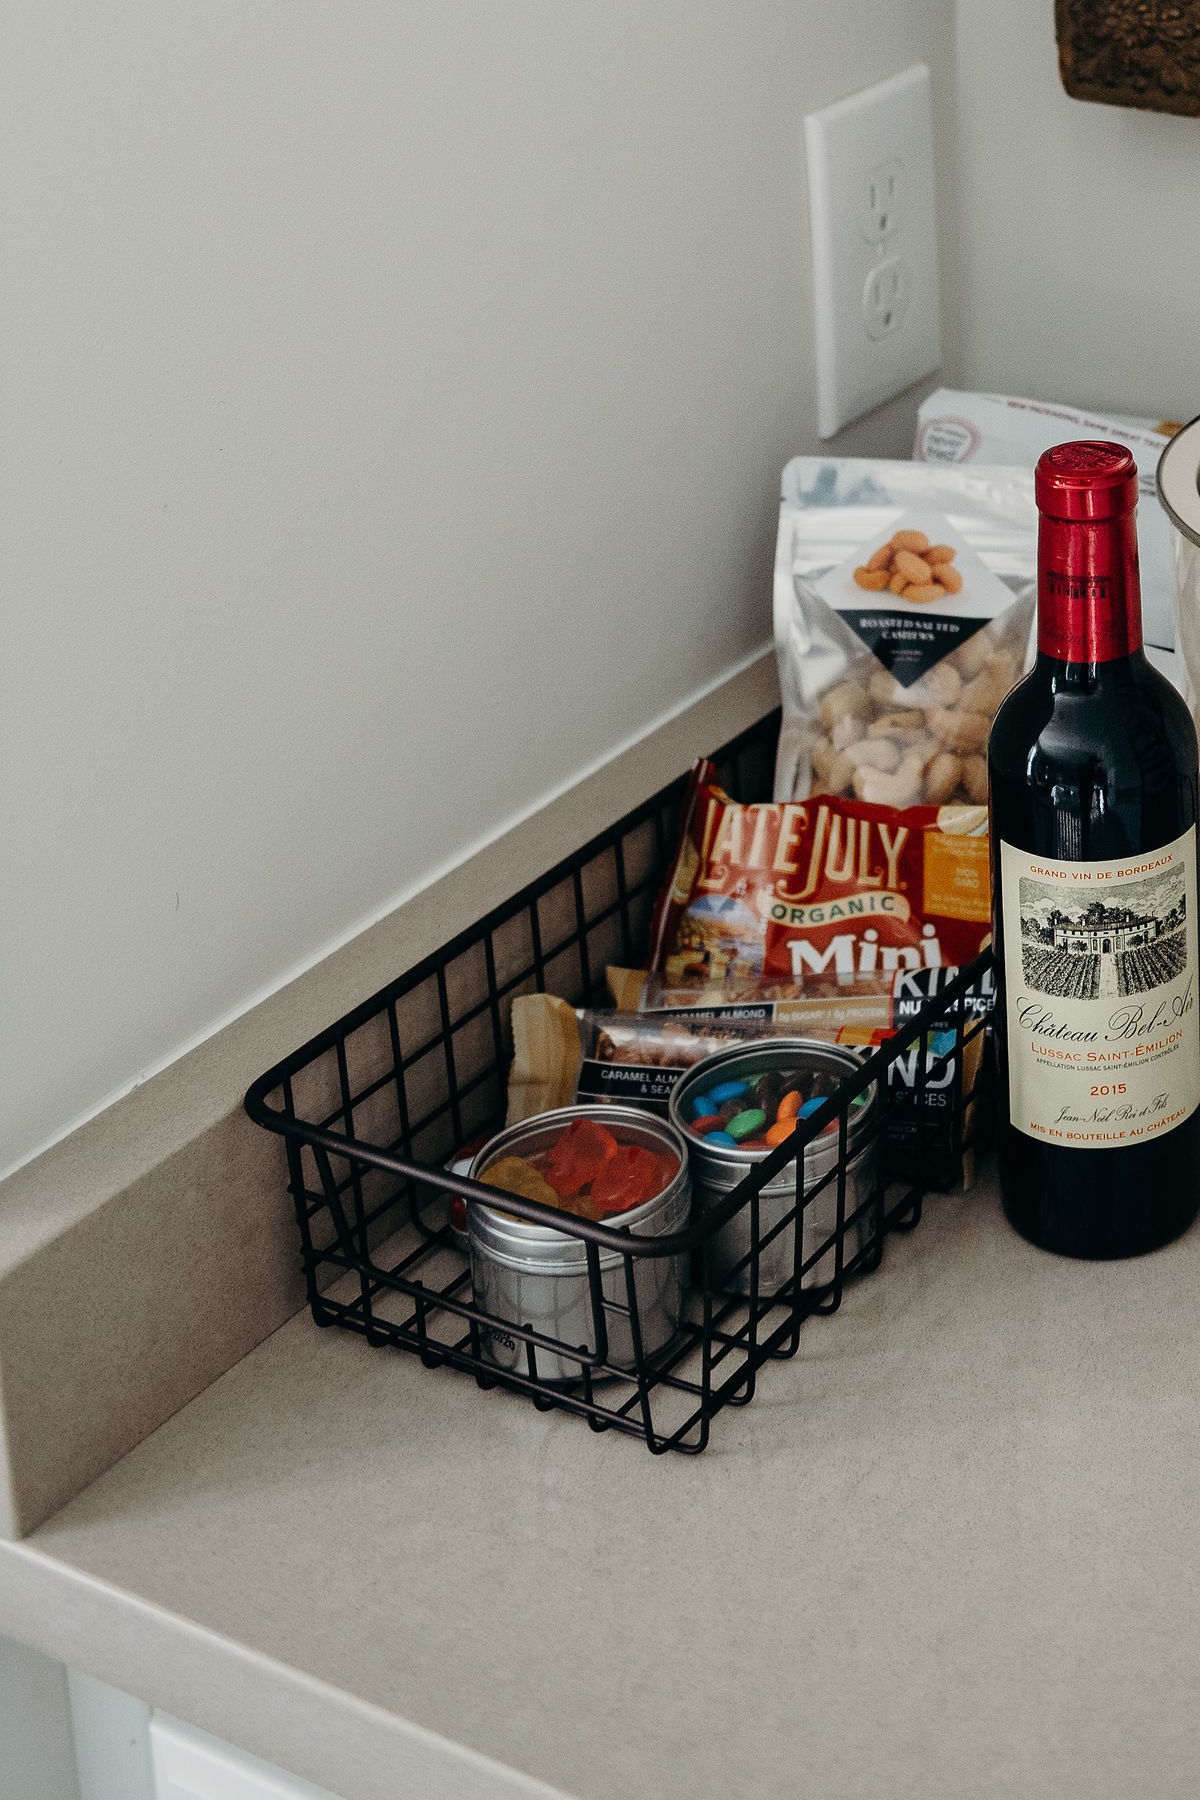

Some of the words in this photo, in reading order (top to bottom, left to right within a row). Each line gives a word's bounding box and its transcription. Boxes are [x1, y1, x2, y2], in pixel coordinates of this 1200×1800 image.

[697, 799, 808, 889] LATE
[1030, 865, 1067, 879] GRAND
[1097, 872, 1112, 880] DE
[1117, 854, 1173, 878] BORDEAUX
[771, 895, 896, 924] ORGANIC
[787, 923, 942, 984] Mini
[1016, 996, 1100, 1042] Château
[1104, 973, 1194, 1042] Bel-Air
[1031, 1042, 1082, 1062] LUSSAC
[1036, 1057, 1076, 1071] APPELLATION
[601, 1069, 651, 1083] CARAMEL
[655, 1074, 679, 1085] ALM
[640, 1084, 648, 1093] &
[1090, 1083, 1127, 1096] 2015
[1030, 1122, 1046, 1134] MIS
[1049, 1129, 1063, 1138] EN
[1066, 1131, 1126, 1141] BOUTEILLE
[1129, 1127, 1144, 1137] AU
[1147, 1107, 1186, 1132] CHÂTEAU
